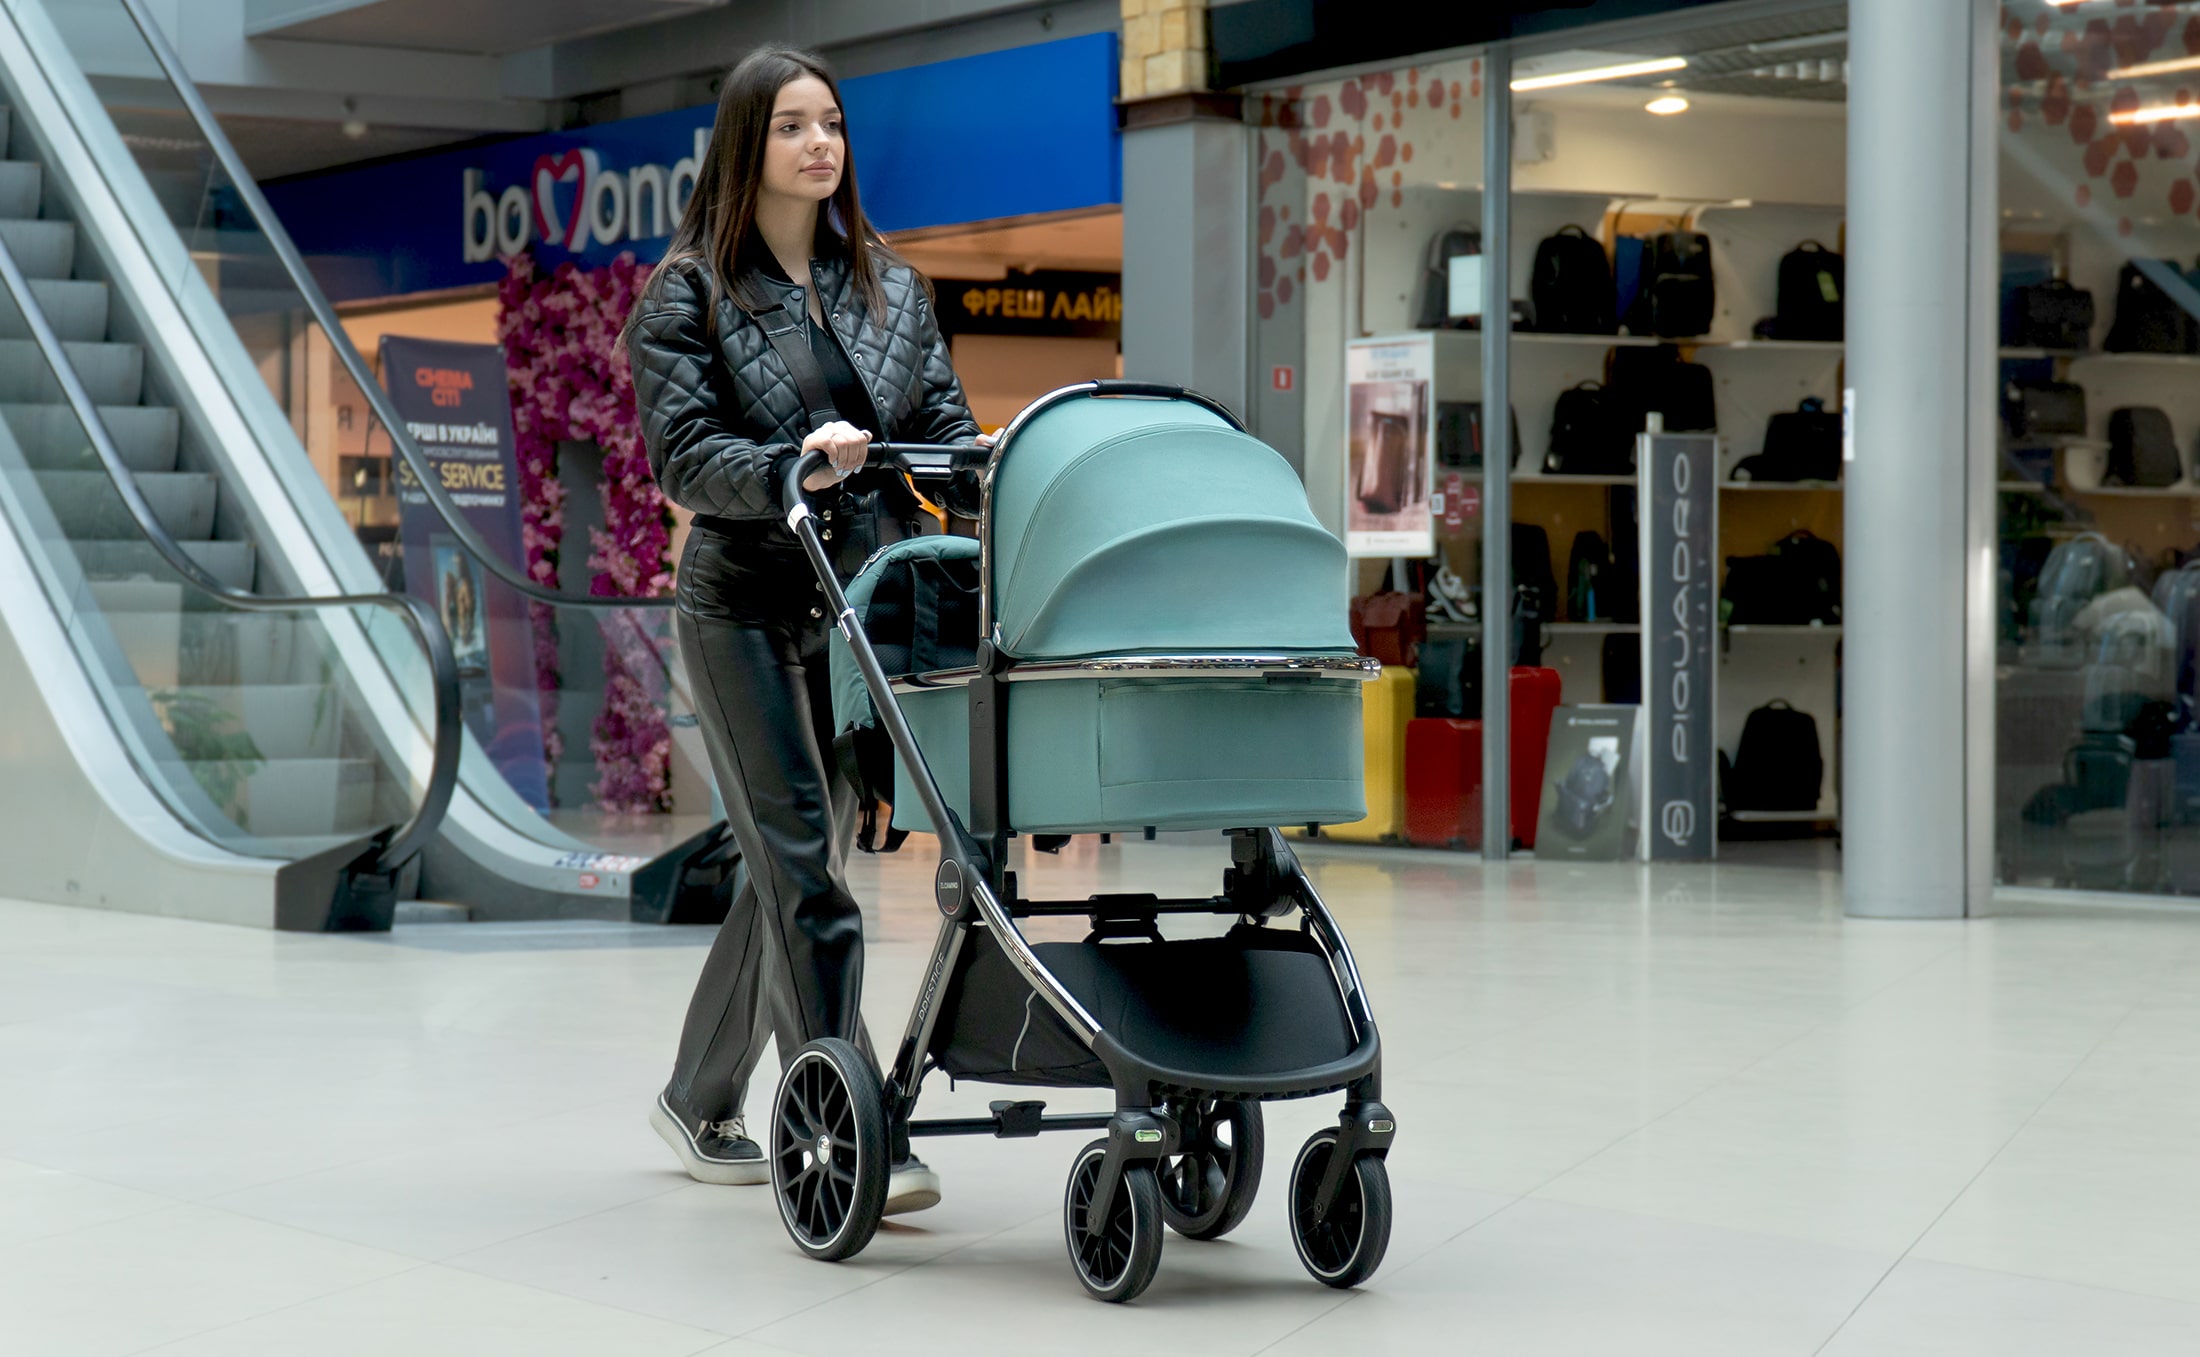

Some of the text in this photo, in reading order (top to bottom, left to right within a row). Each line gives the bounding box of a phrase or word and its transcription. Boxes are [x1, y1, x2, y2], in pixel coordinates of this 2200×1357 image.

[962, 288, 1045, 319] ФРЕШ
[448, 421, 498, 445] УКРАЇНІ
[440, 461, 505, 490] SERVICE
[1672, 452, 1692, 763] PIQUADRO
